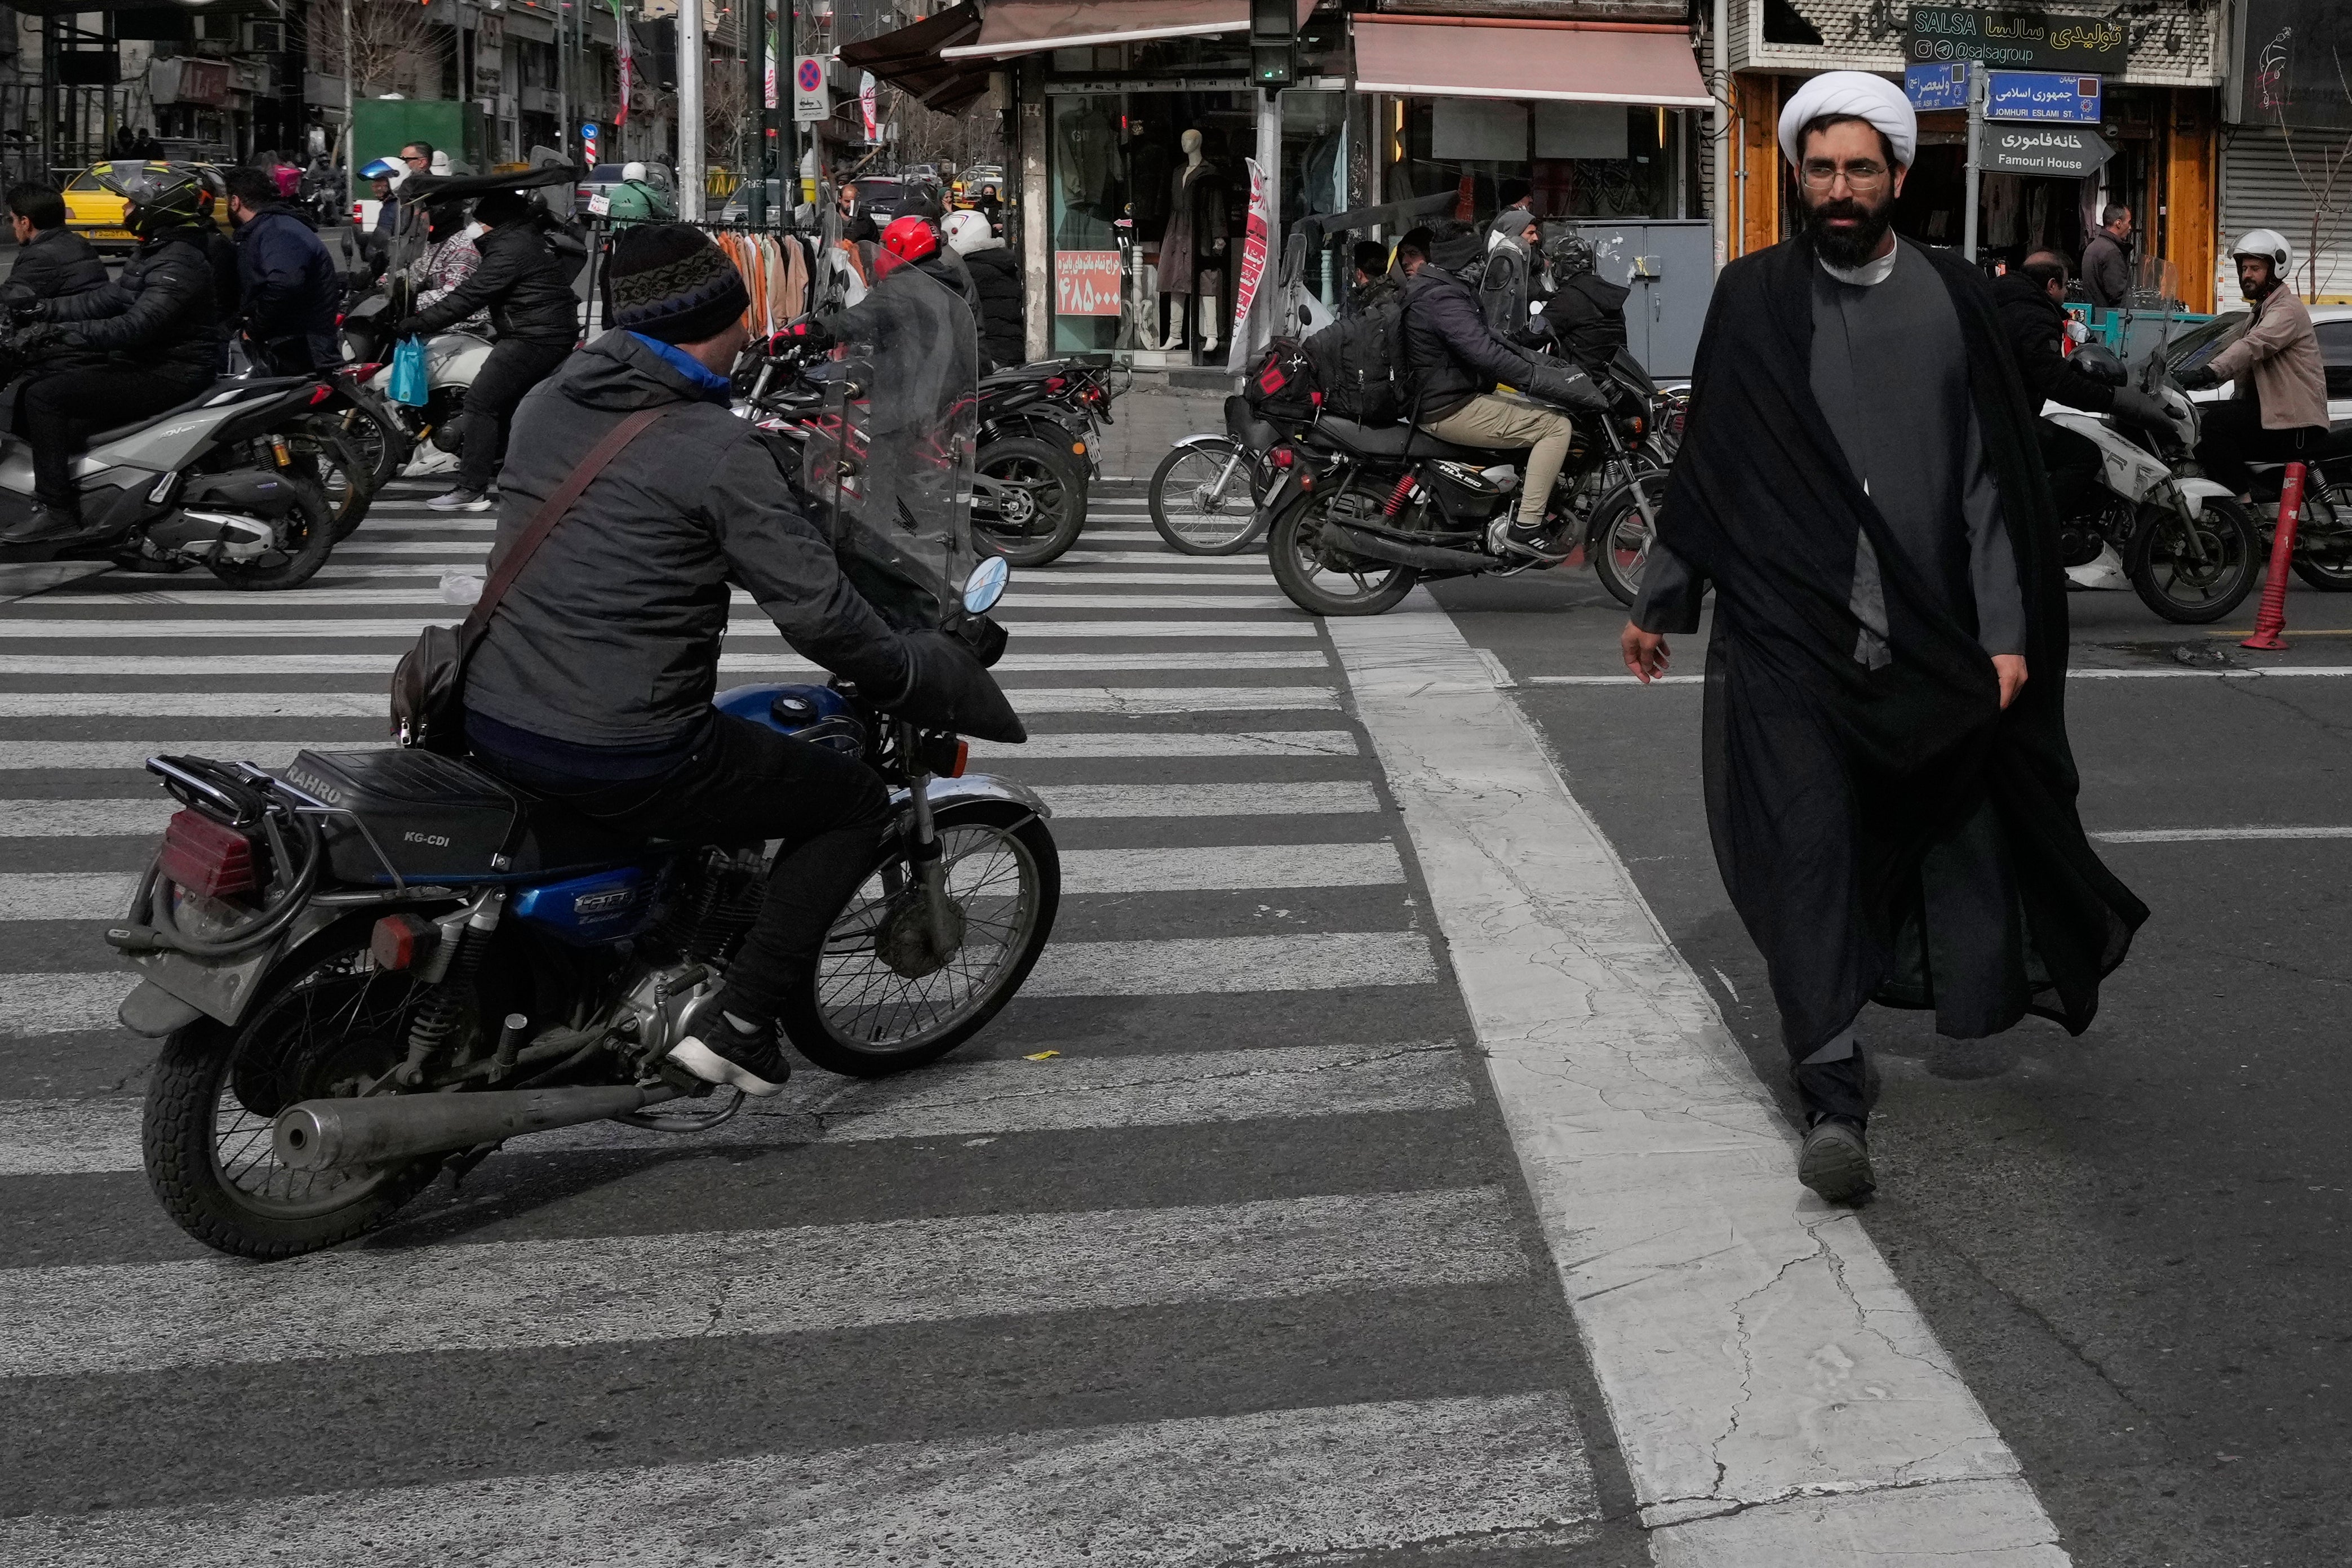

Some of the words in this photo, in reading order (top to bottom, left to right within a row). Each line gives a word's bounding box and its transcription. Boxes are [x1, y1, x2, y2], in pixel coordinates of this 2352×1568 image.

[1914, 11, 1977, 35] SALSA
[1985, 16, 2044, 40] سالسا
[2050, 23, 2122, 52] تولیدی
[1956, 42, 2033, 64] @salsagroup
[1918, 75, 1950, 99] ولیعصر
[1995, 87, 2031, 102] اسلامی
[2033, 90, 2073, 102] جمهوری
[1995, 108, 2029, 117] JOMHURI
[2033, 109, 2060, 118] ESLAMI
[2002, 132, 2053, 151] فاموری
[2053, 135, 2082, 148] خانه
[1998, 153, 2044, 167] Famouri
[2047, 157, 2082, 169] House
[1094, 254, 1106, 275] تمام
[1105, 254, 1120, 275] حراج
[1058, 277, 1120, 312] ۴۸۵۰۰۰
[404, 830, 451, 848] KG-CDI
